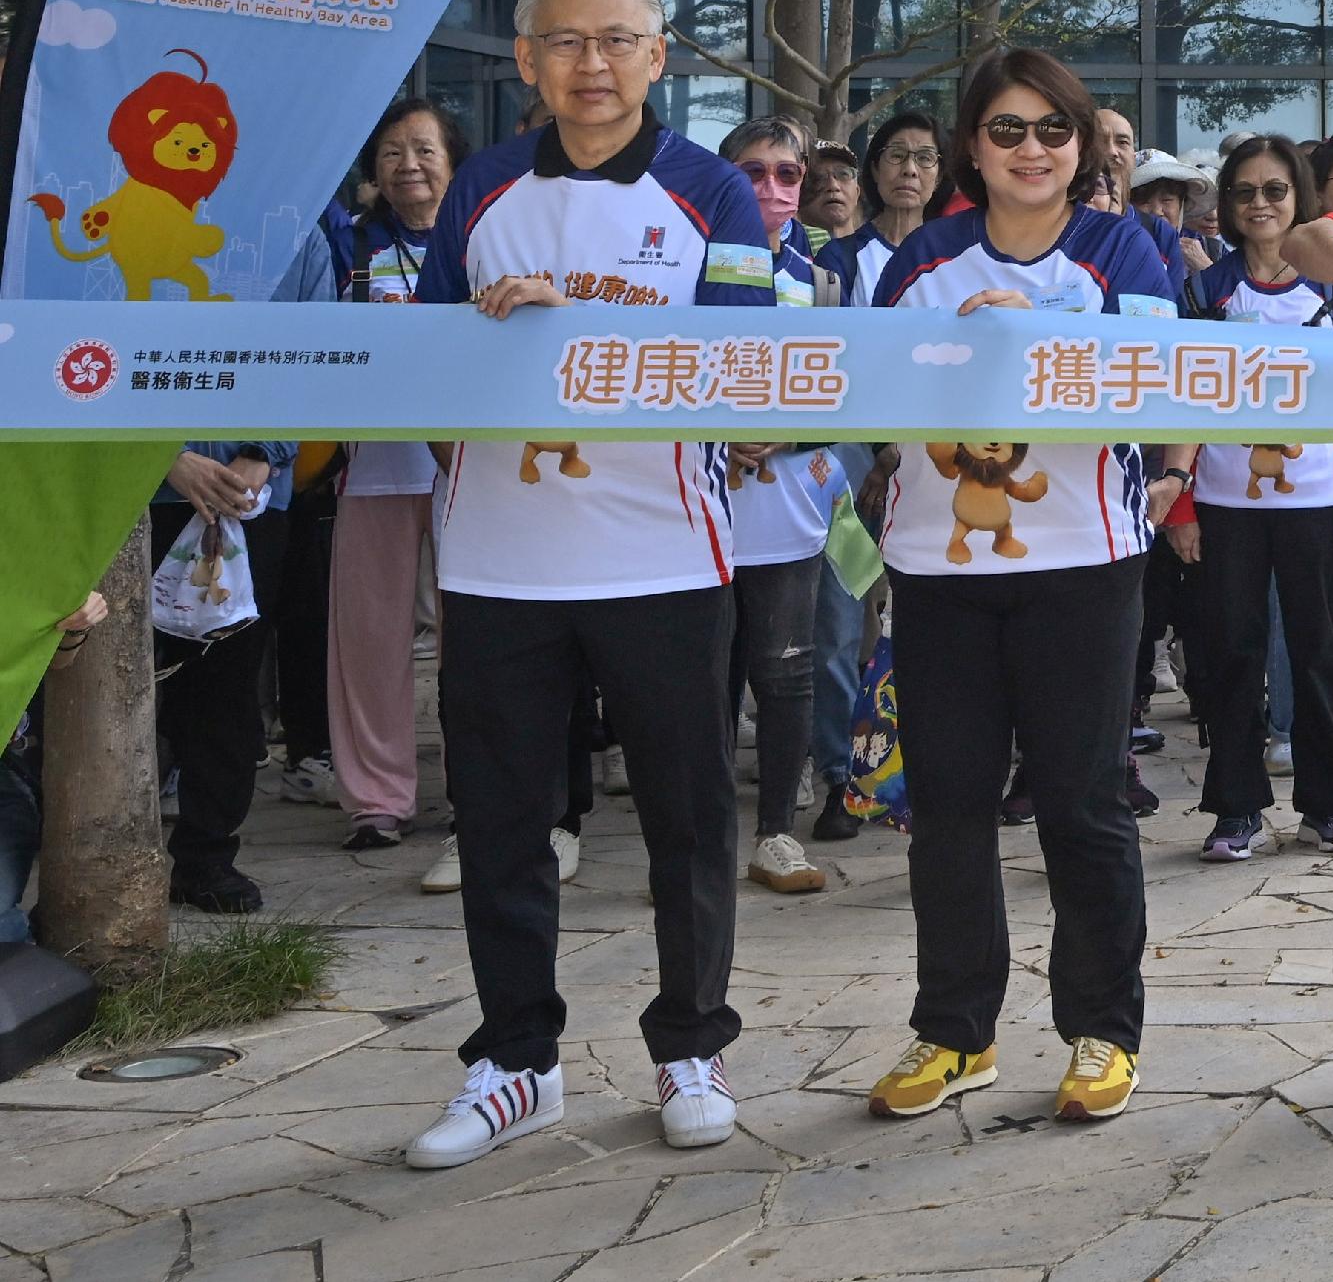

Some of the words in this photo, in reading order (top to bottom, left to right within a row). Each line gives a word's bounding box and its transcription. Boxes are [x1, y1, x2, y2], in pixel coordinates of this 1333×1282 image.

[255, 2, 313, 21] Healthy
[318, 9, 344, 25] Bay
[350, 14, 388, 28] Area
[133, 350, 372, 366] 中華人民共和國香港特別行政區政府
[561, 338, 845, 409] 健康灣區
[1027, 345, 1311, 409] 攜手同行
